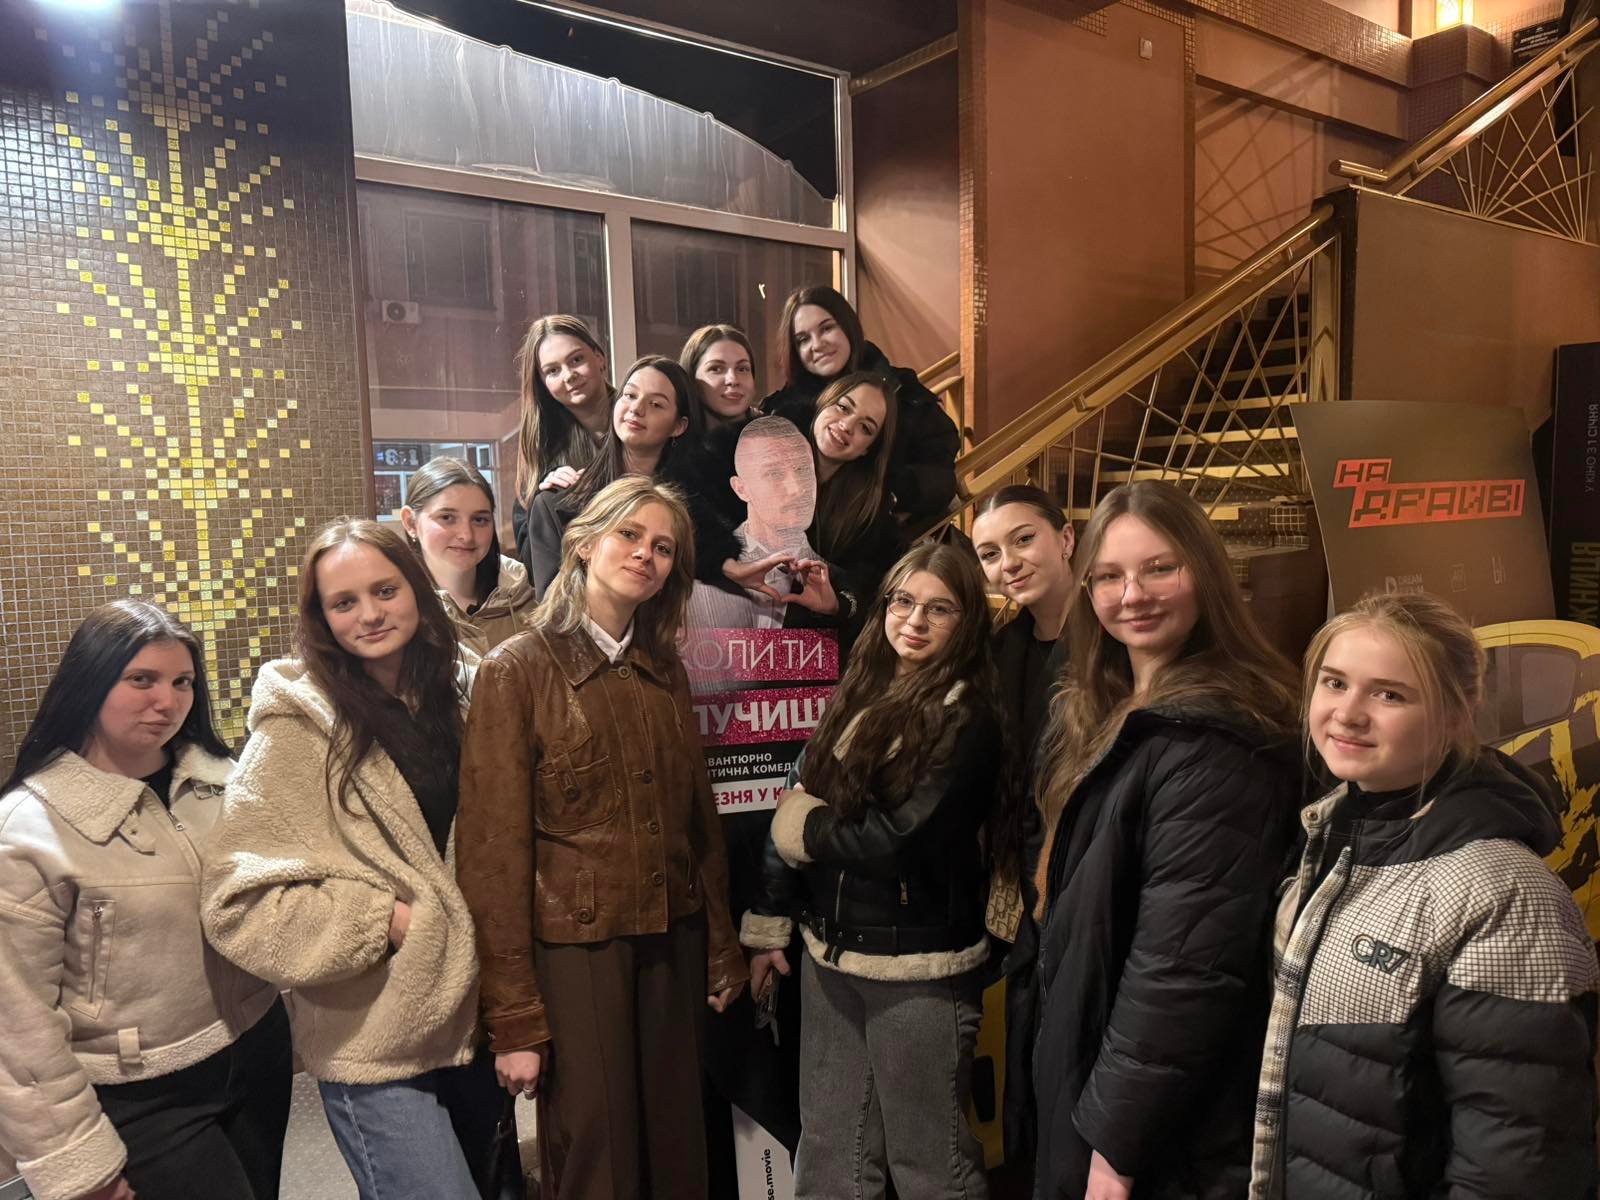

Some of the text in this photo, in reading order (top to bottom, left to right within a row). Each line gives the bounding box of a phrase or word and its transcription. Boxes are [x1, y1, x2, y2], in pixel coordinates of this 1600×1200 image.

[1587, 404, 1600, 438] СІЧНЯ
[1337, 461, 1390, 484] НА
[782, 639, 823, 671] ТИ
[705, 752, 772, 768] ВАНТЮРНО
[757, 787, 768, 802] У
[1352, 933, 1410, 975] CR7
